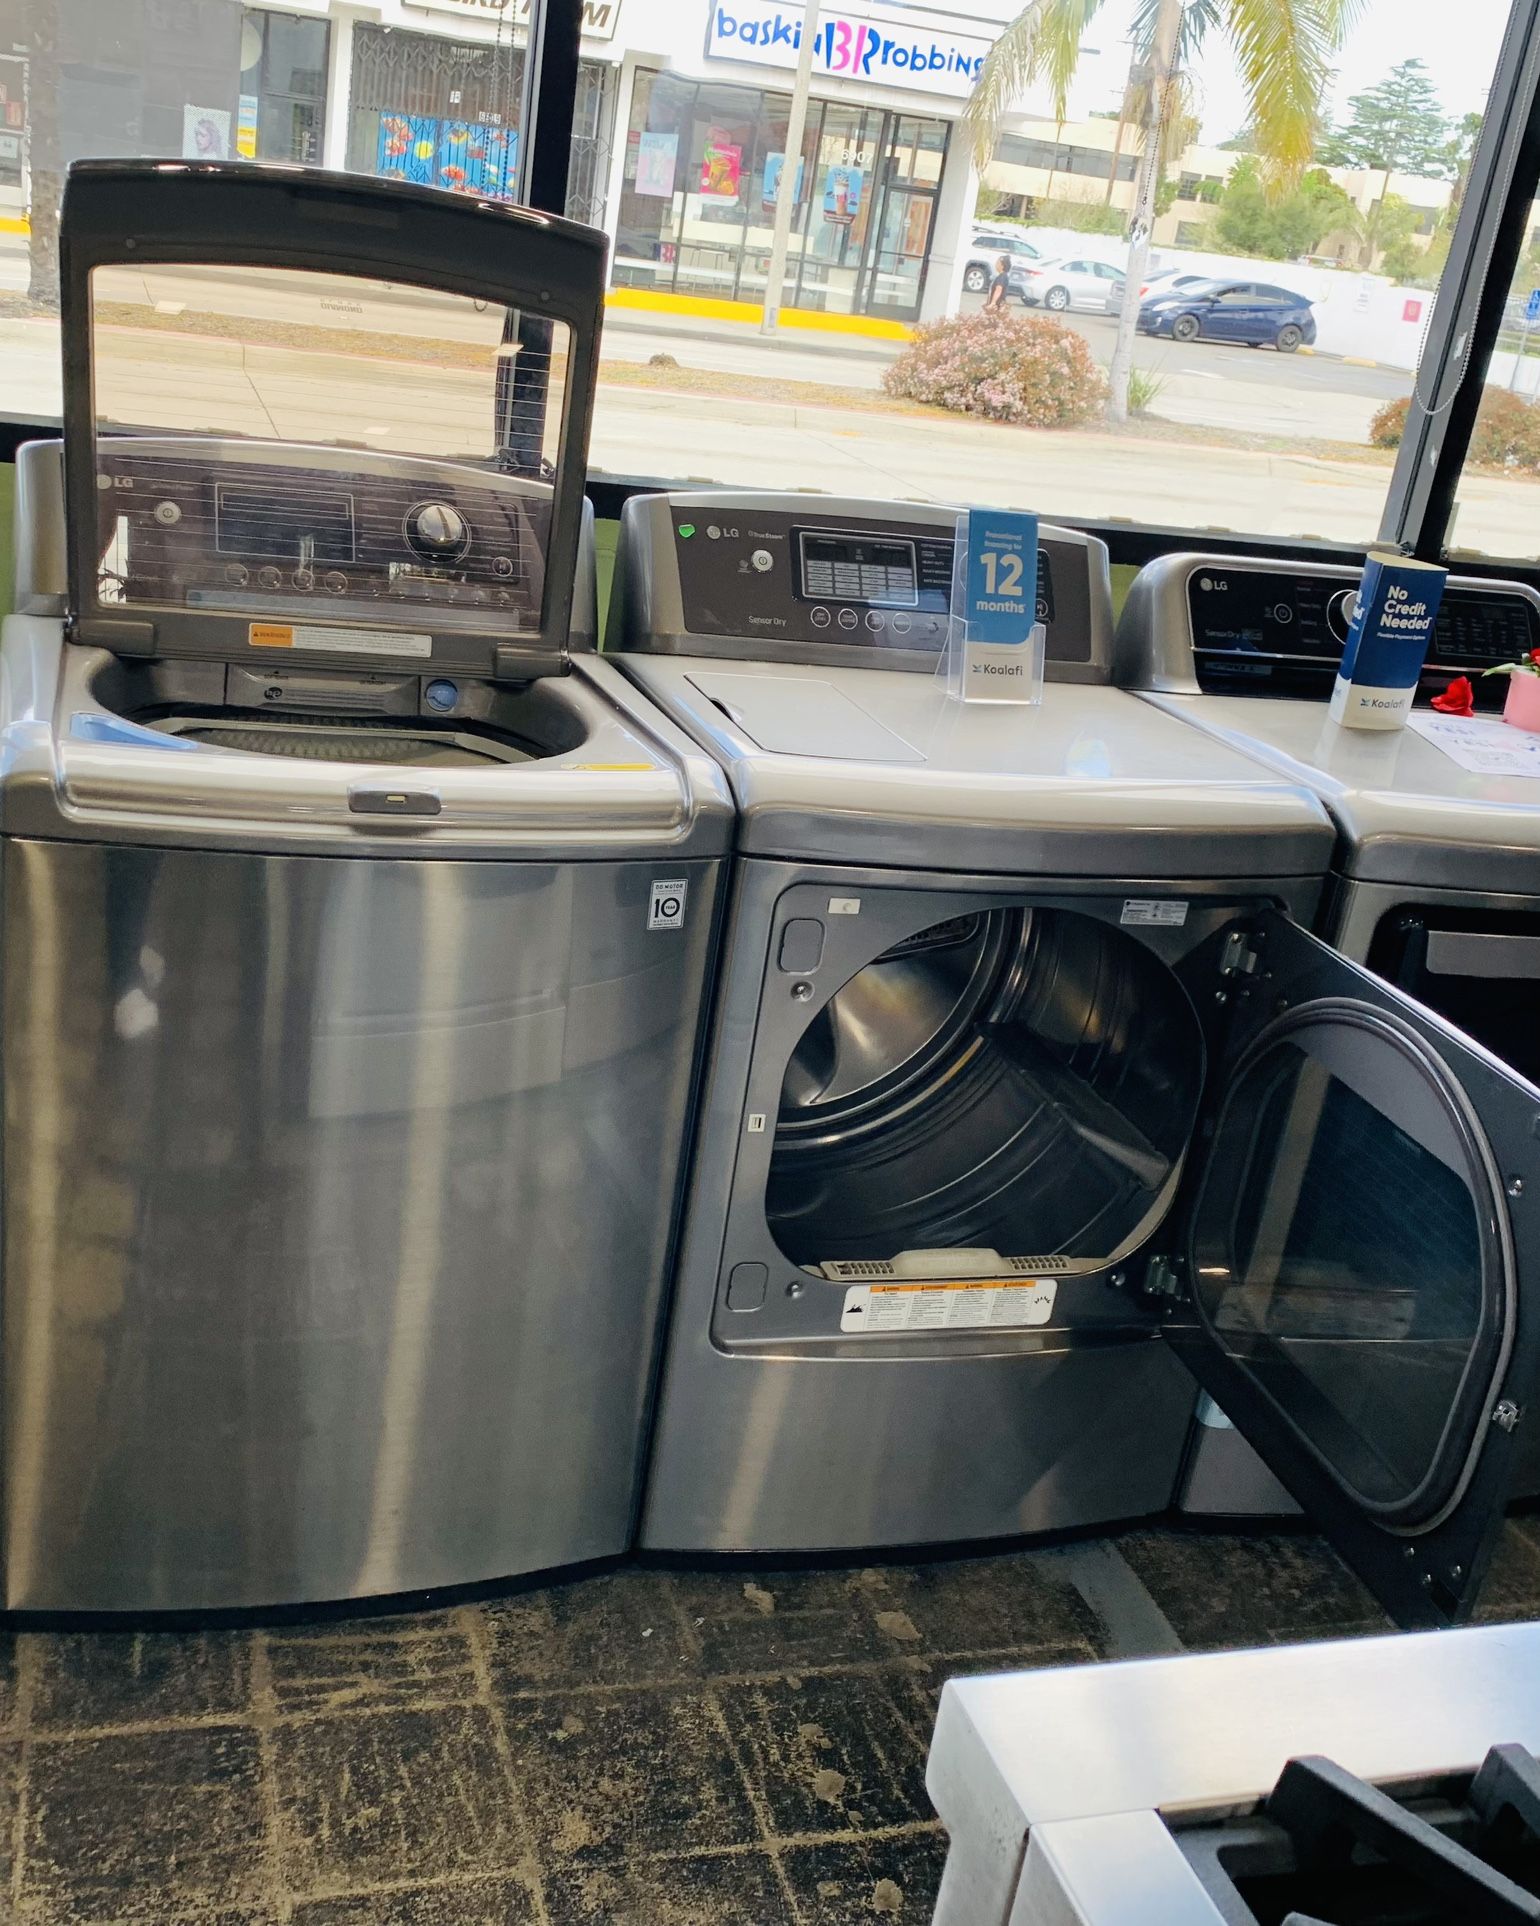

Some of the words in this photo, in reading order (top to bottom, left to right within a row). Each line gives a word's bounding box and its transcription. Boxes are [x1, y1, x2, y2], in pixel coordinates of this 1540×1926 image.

[113, 477, 134, 488] LG
[722, 527, 740, 538] LG
[980, 552, 1024, 596] 12
[1213, 580, 1228, 591] LG
[1387, 585, 1408, 600] No
[976, 600, 1025, 613] months
[1384, 599, 1427, 616] Credit
[748, 615, 772, 625] Sensor
[773, 617, 787, 628] Dry
[1380, 614, 1431, 630] Needed
[984, 663, 1023, 676] Koalafi
[654, 897, 680, 918] 10
